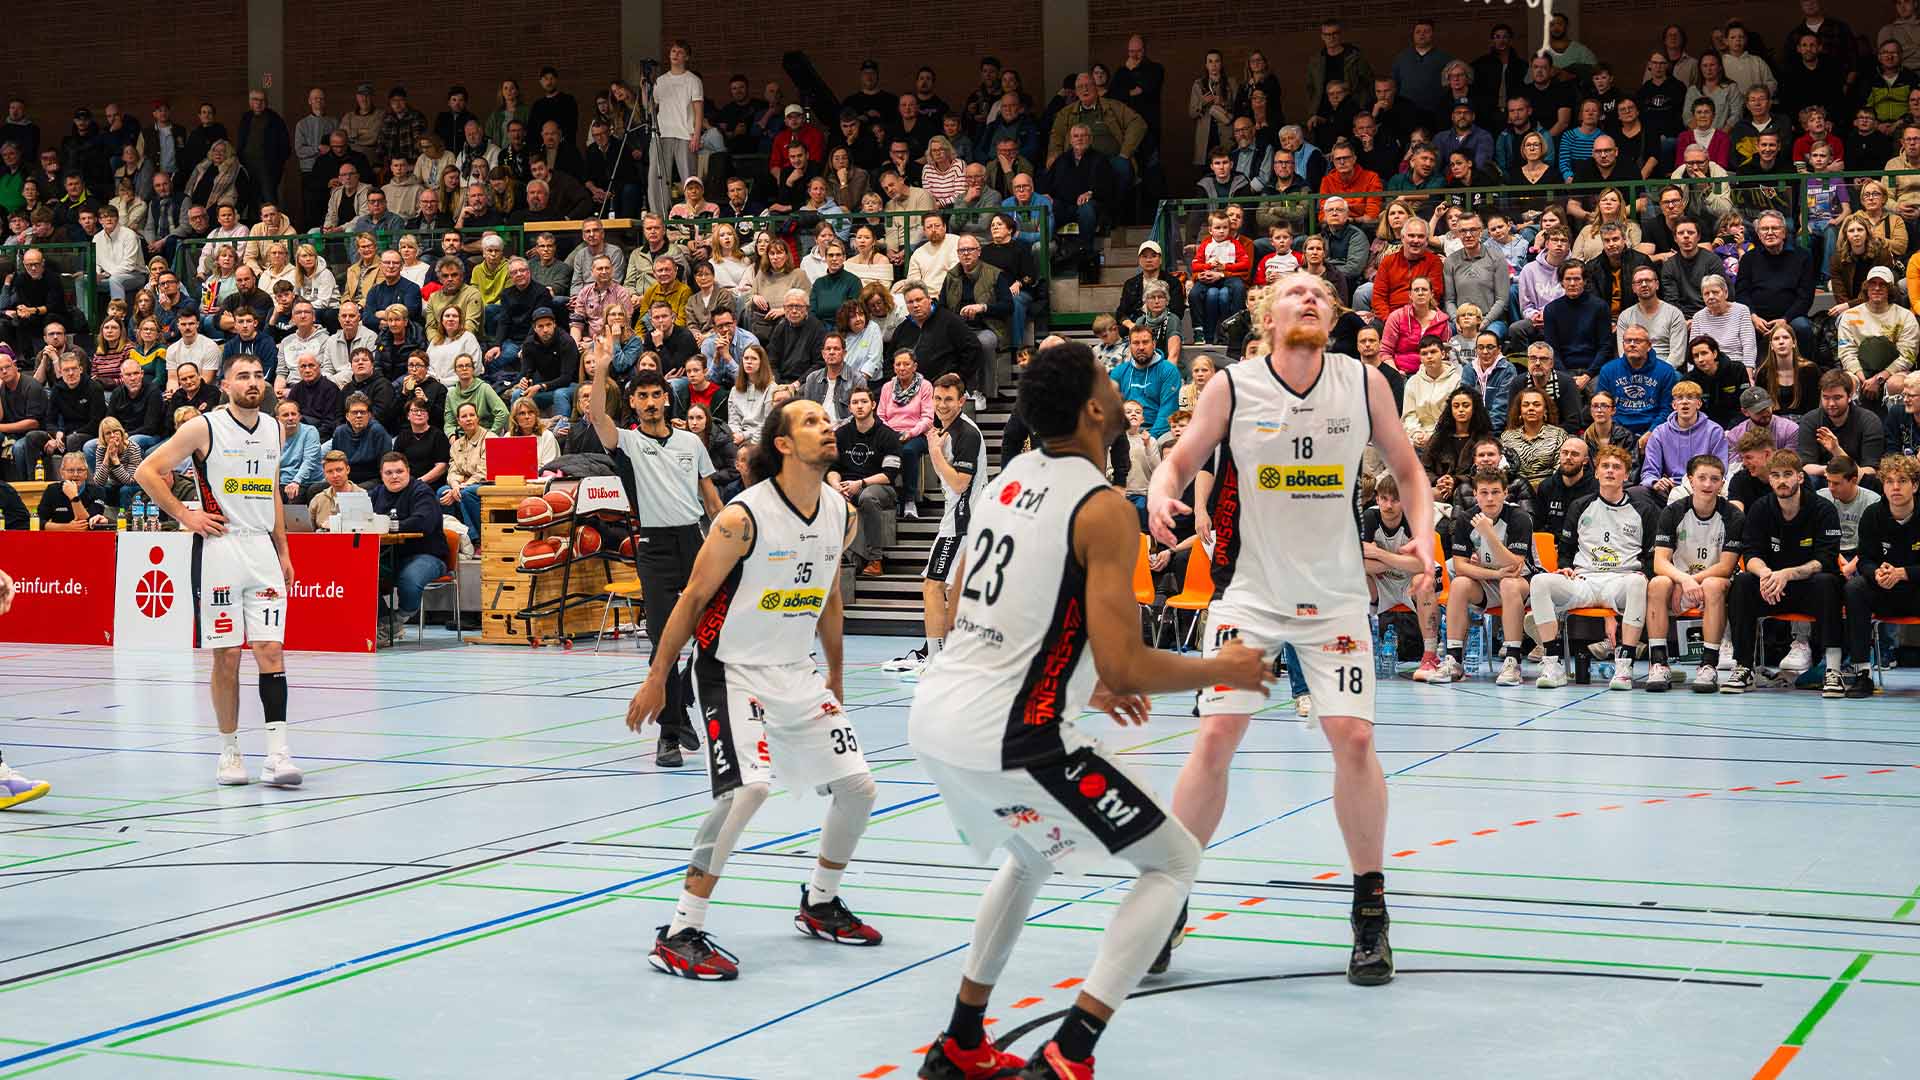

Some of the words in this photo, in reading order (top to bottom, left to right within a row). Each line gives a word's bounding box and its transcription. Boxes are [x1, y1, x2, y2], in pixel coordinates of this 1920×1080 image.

[1327, 425, 1351, 434] DENT
[1292, 436, 1313, 460] 18
[246, 459, 259, 475] 11
[241, 480, 273, 492] BÖRGEL
[1286, 470, 1343, 486] BÖRGEL
[587, 487, 620, 500] Wilson
[1603, 531, 1611, 543] 8
[1485, 552, 1492, 563] 6
[1696, 547, 1708, 560] 16
[794, 561, 814, 584] 35
[962, 528, 1015, 606] 23
[262, 607, 279, 627] 11
[1335, 665, 1363, 695] 18
[830, 727, 858, 755] 35
[1096, 787, 1141, 827] tvi
